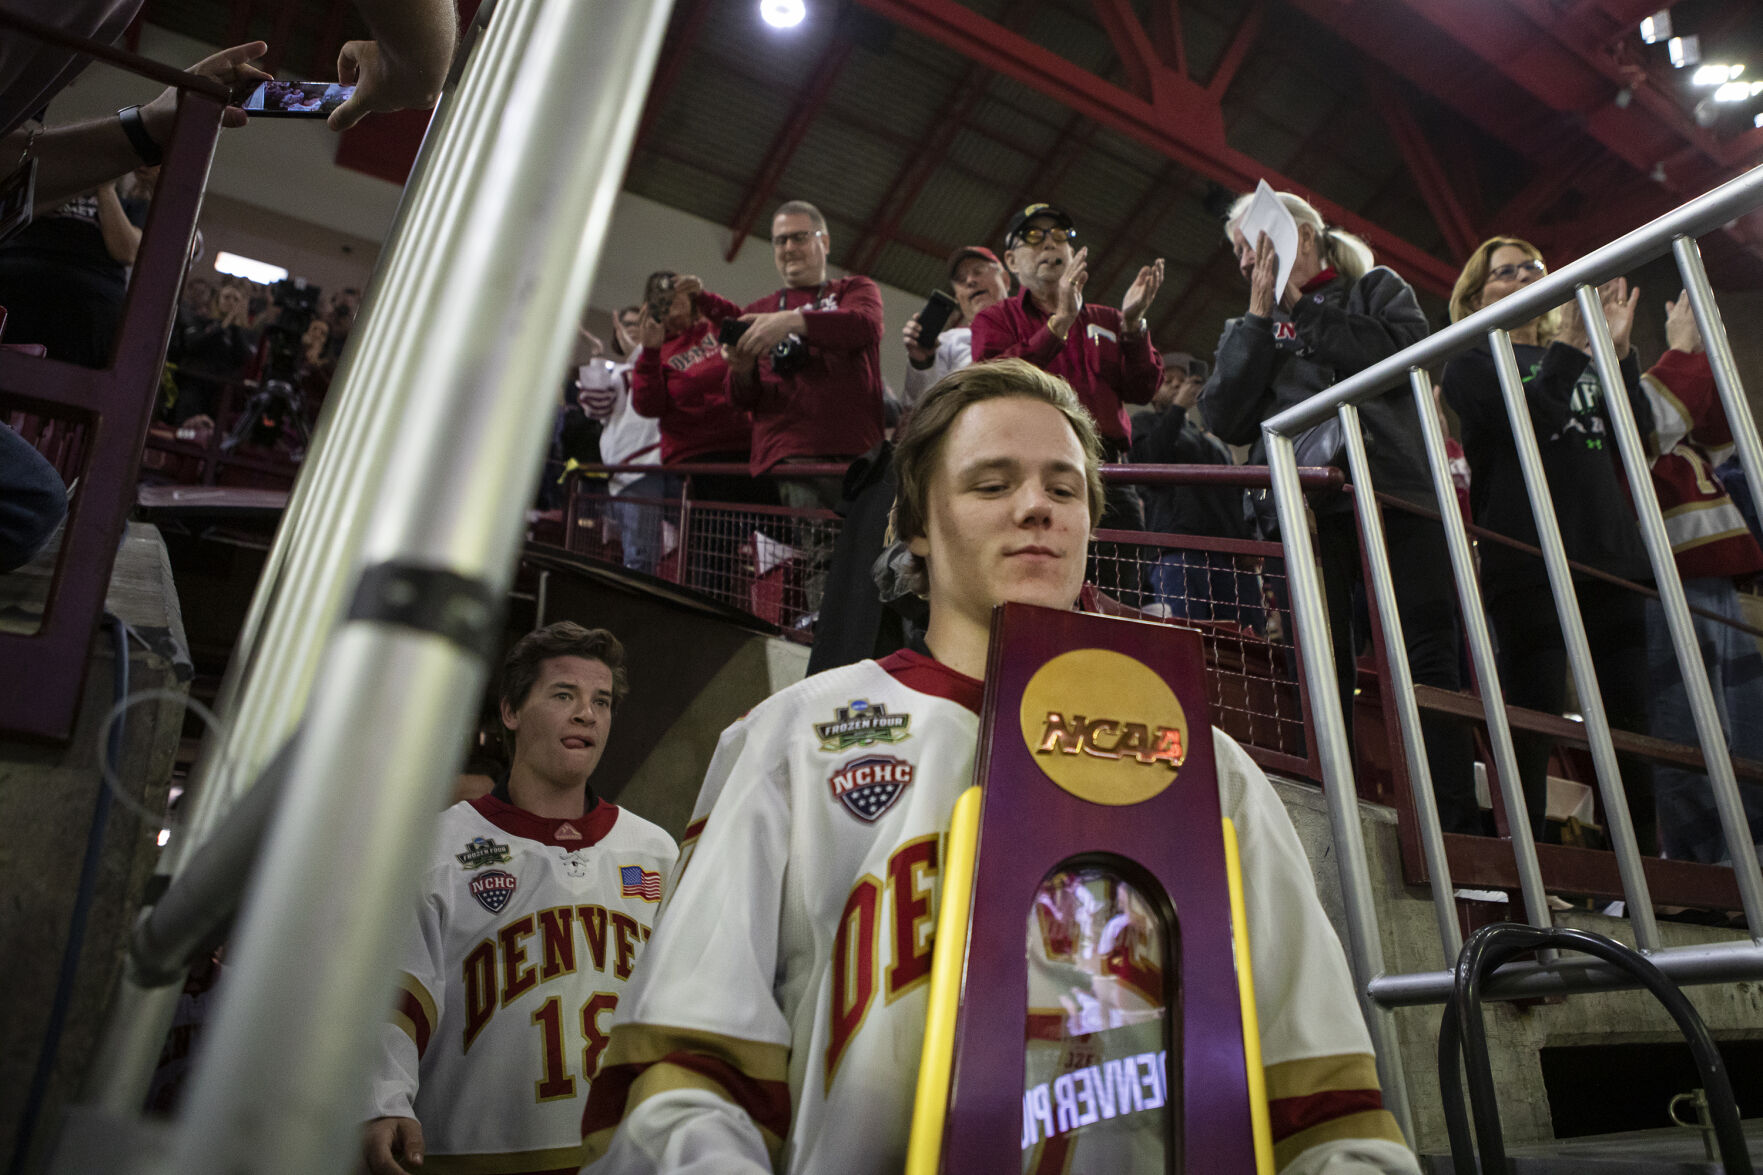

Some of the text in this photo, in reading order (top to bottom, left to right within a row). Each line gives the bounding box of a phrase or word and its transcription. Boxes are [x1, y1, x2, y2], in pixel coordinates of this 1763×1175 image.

[824, 717, 904, 737] FROZEN FOUR
[1036, 712, 1184, 770] NCAA
[832, 765, 911, 795] NCHC
[471, 877, 515, 893] NCHC
[463, 904, 652, 1056] DENVE
